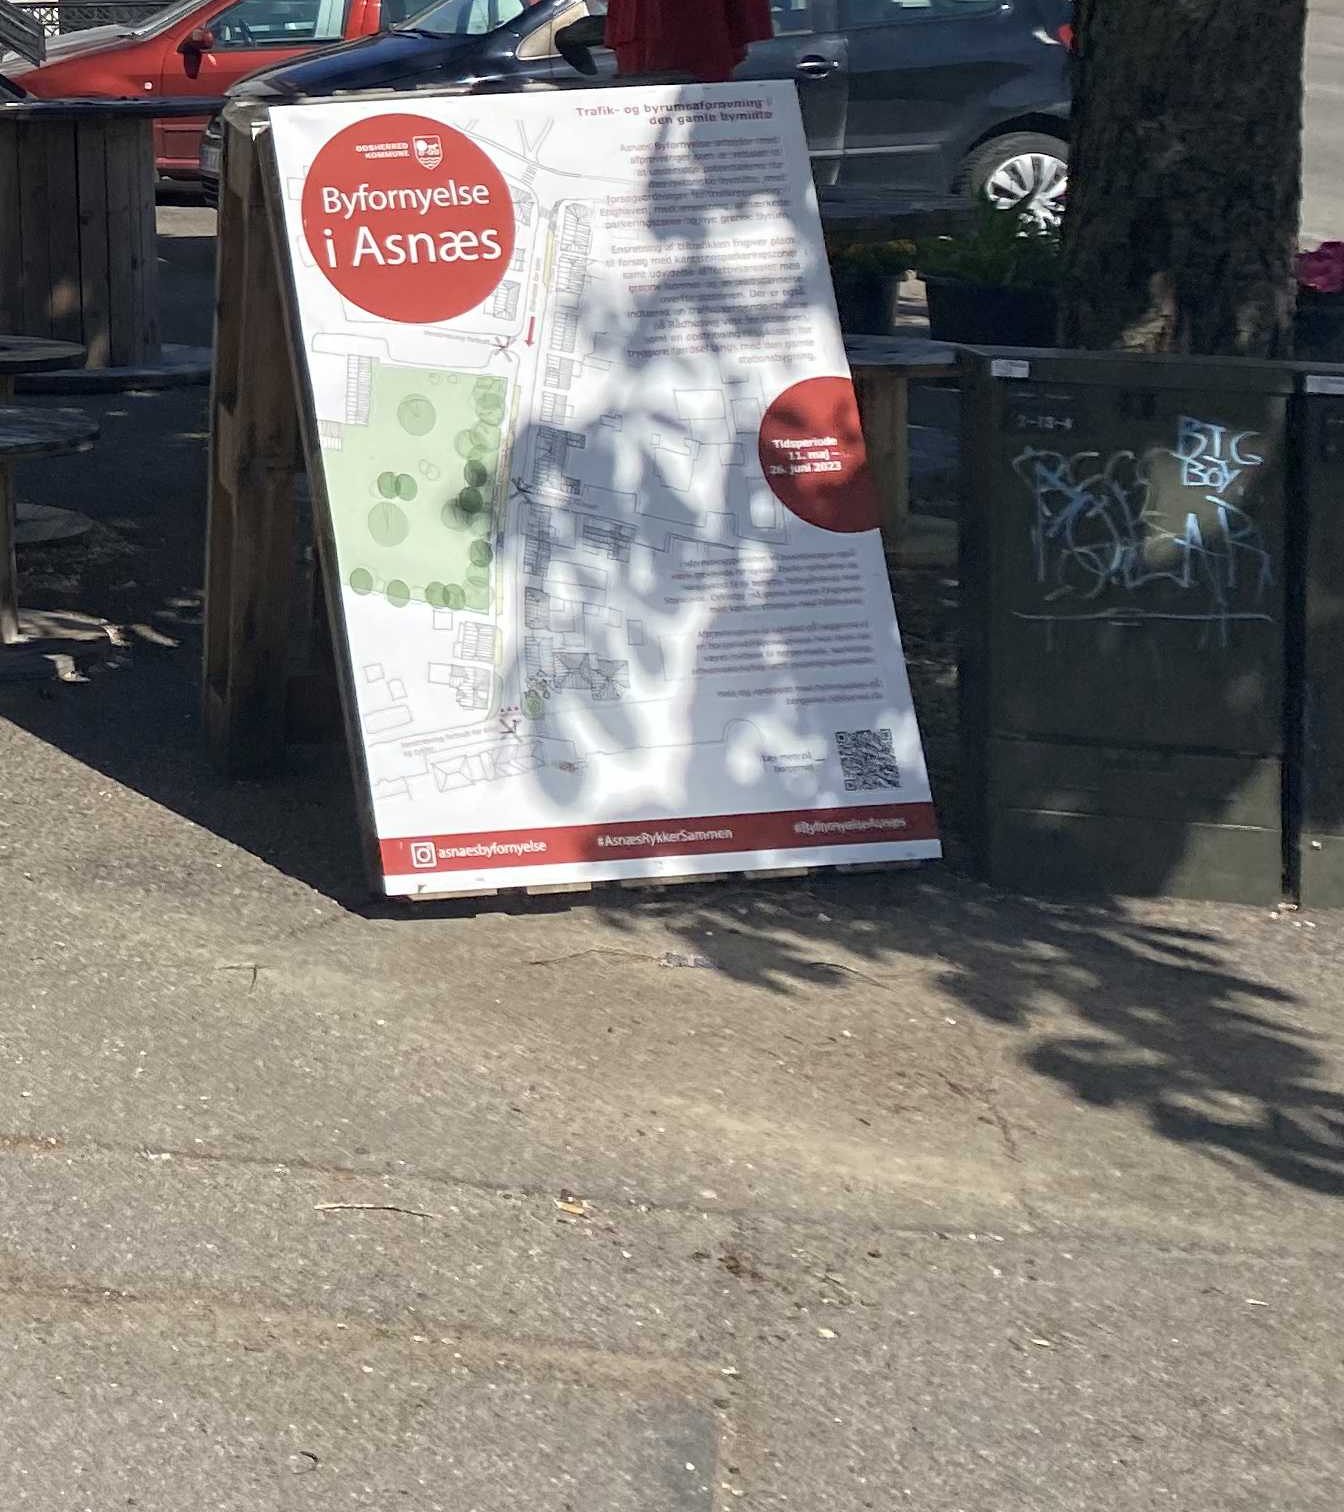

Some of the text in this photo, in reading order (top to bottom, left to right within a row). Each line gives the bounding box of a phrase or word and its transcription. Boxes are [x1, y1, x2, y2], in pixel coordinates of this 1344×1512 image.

[576, 105, 620, 117] Trafik-
[624, 105, 640, 115] og
[649, 116, 673, 125] den
[365, 149, 410, 159] KOMMUNE
[321, 179, 490, 220] Byfornyelse
[322, 225, 503, 269] i Asnæs
